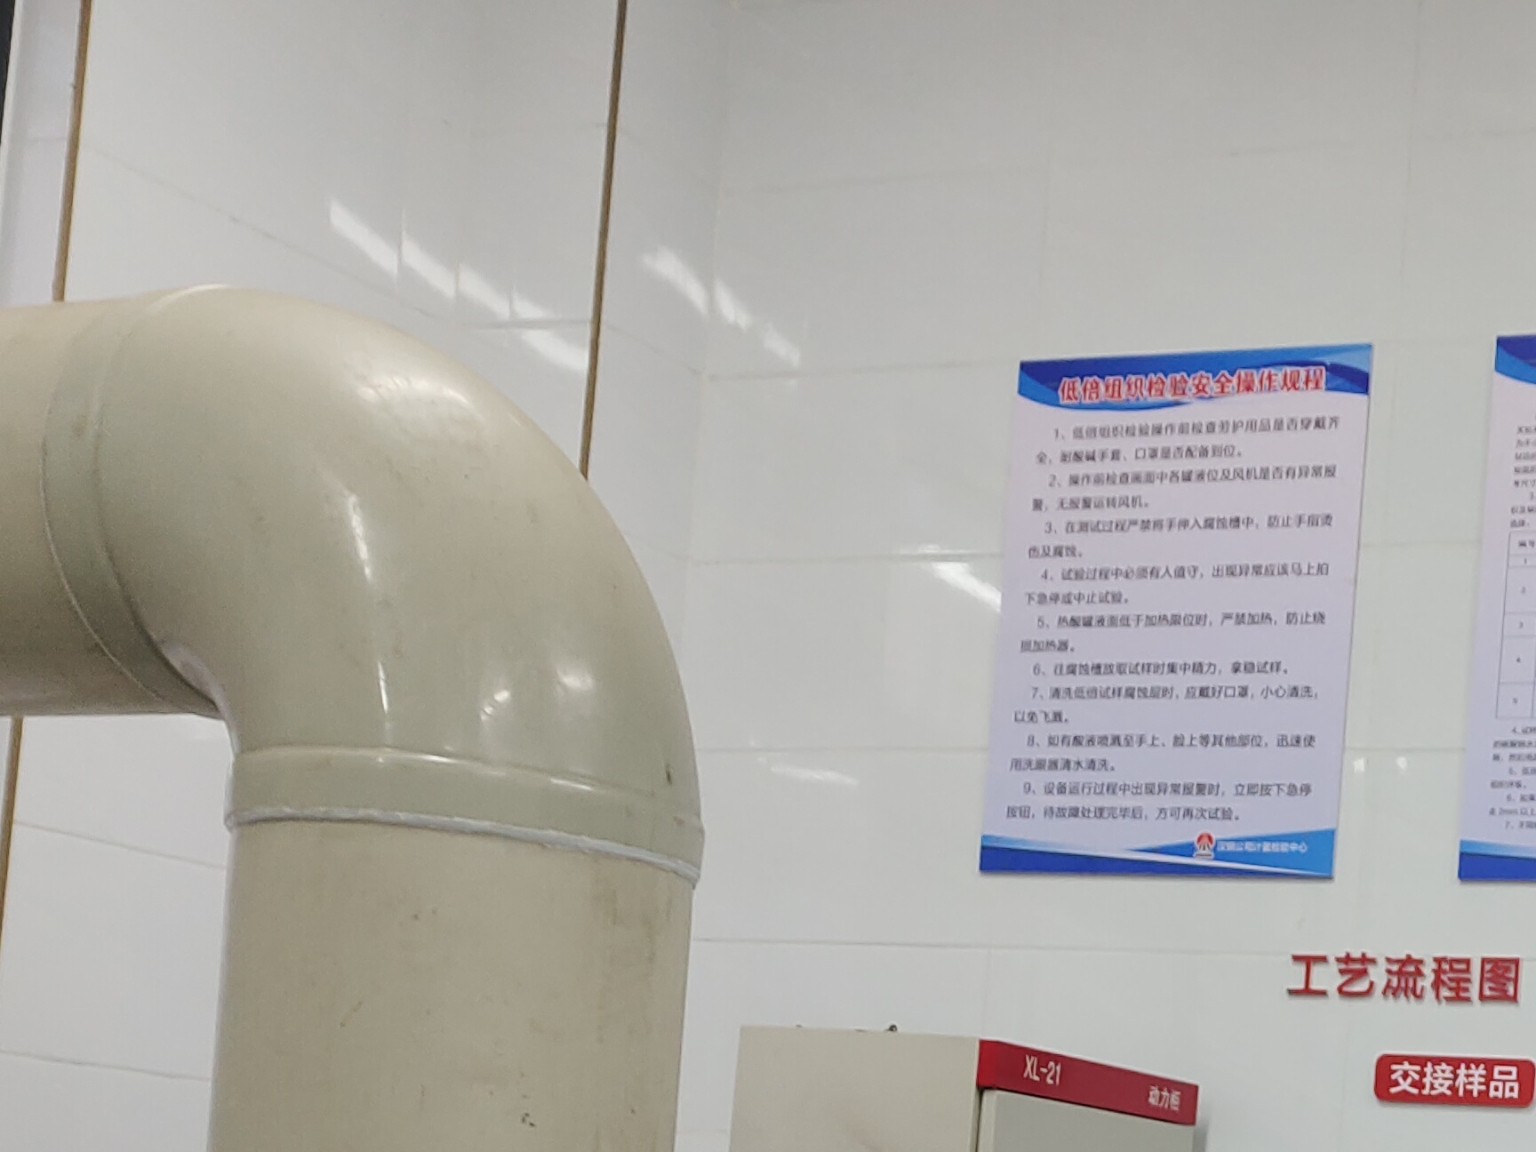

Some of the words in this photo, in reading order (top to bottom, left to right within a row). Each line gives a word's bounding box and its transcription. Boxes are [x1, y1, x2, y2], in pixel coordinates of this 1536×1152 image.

[1058, 365, 1326, 404] 低倍组织检验安全操作规程
[1287, 953, 1521, 1003] 工艺流程图
[1023, 1054, 1062, 1087] XL-21
[1389, 1061, 1520, 1101] 交接样品
